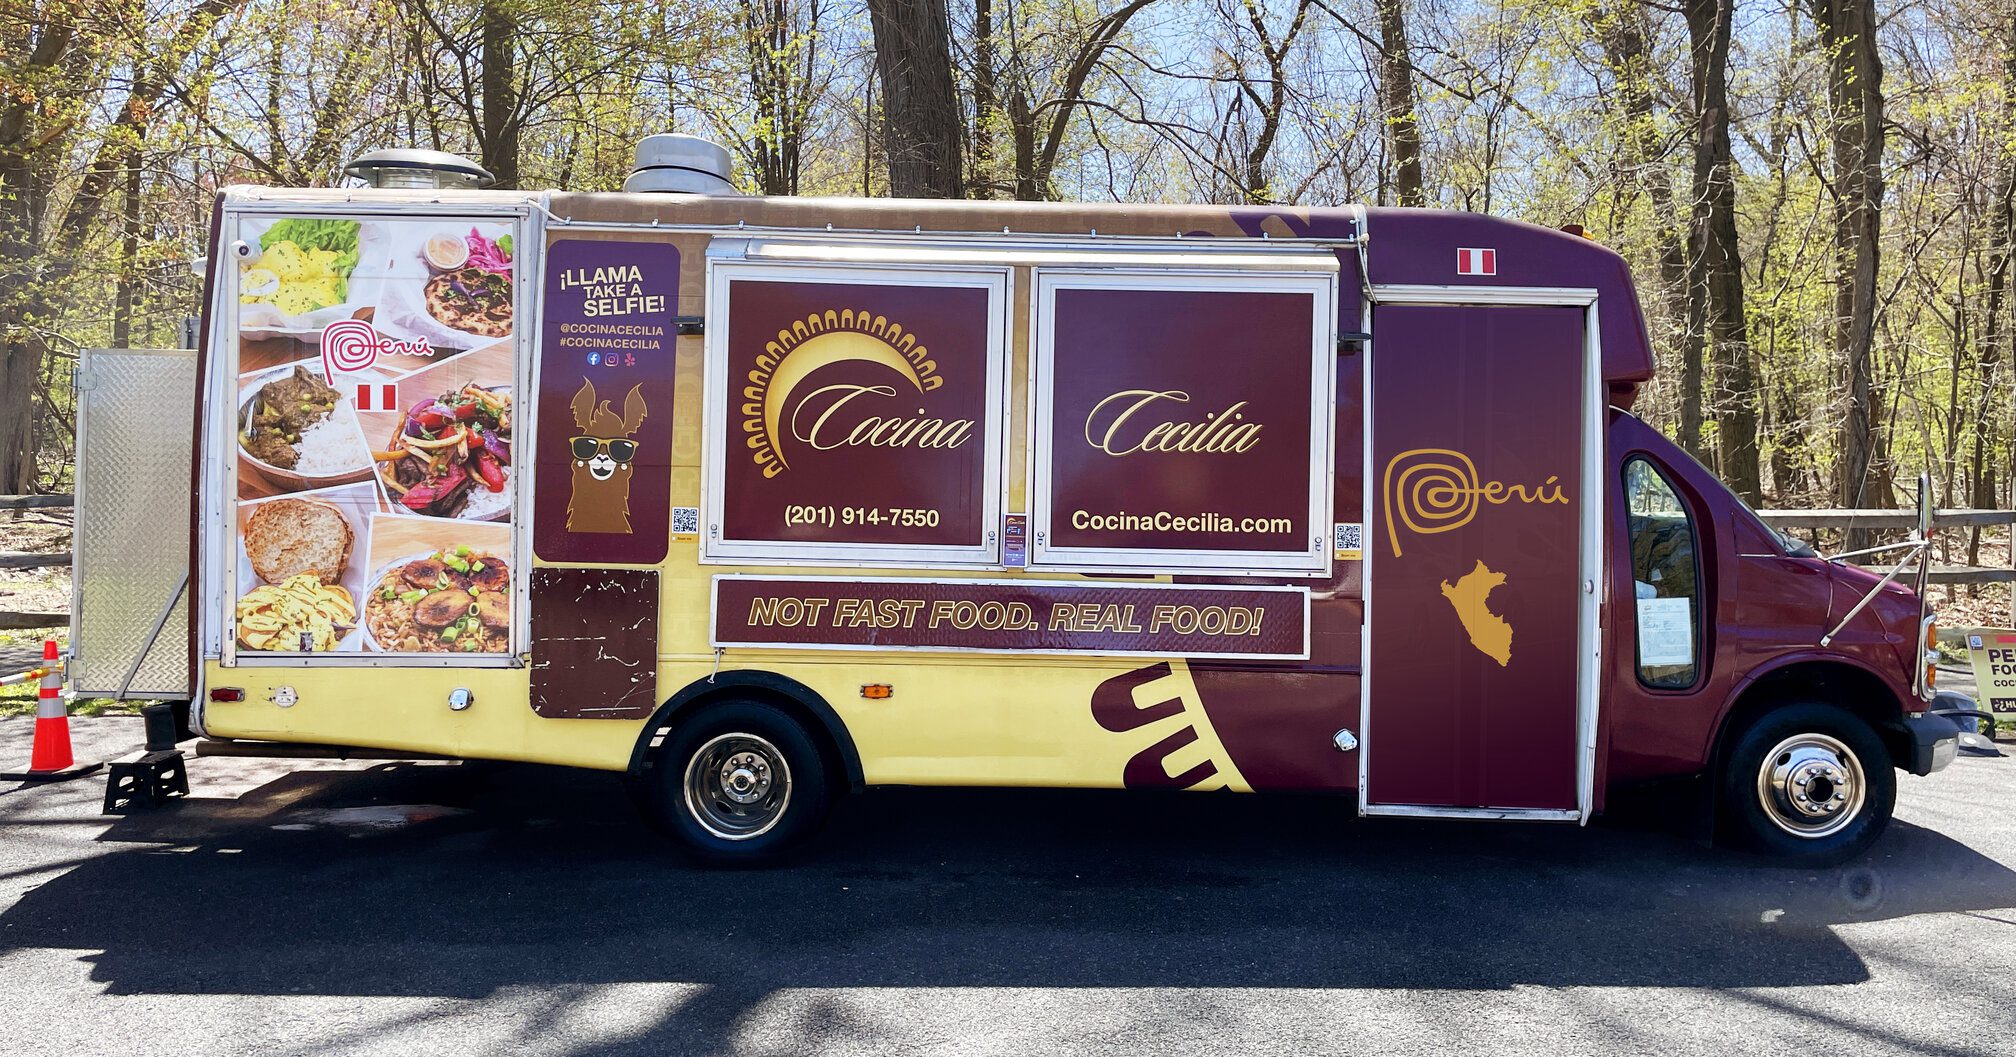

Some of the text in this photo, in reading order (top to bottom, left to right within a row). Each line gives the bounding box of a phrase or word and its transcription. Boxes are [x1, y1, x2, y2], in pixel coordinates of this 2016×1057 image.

[560, 265, 643, 290] ¡LLAMA
[583, 283, 643, 299] TAKE A
[583, 295, 665, 317] SELFIE!
[560, 323, 664, 336] @COCINACECILIA
[559, 337, 660, 350] #COCINACECILIA
[791, 384, 976, 450] Cocina
[1085, 389, 1264, 456] Cecilia
[784, 505, 940, 528] (201) 914-7550
[1071, 510, 1292, 533] CocinaCecilia.com
[748, 597, 1264, 635] NOT FAST FOOD. REAL FOOD!
[1988, 648, 2016, 663] PE
[1993, 679, 2016, 687] COC
